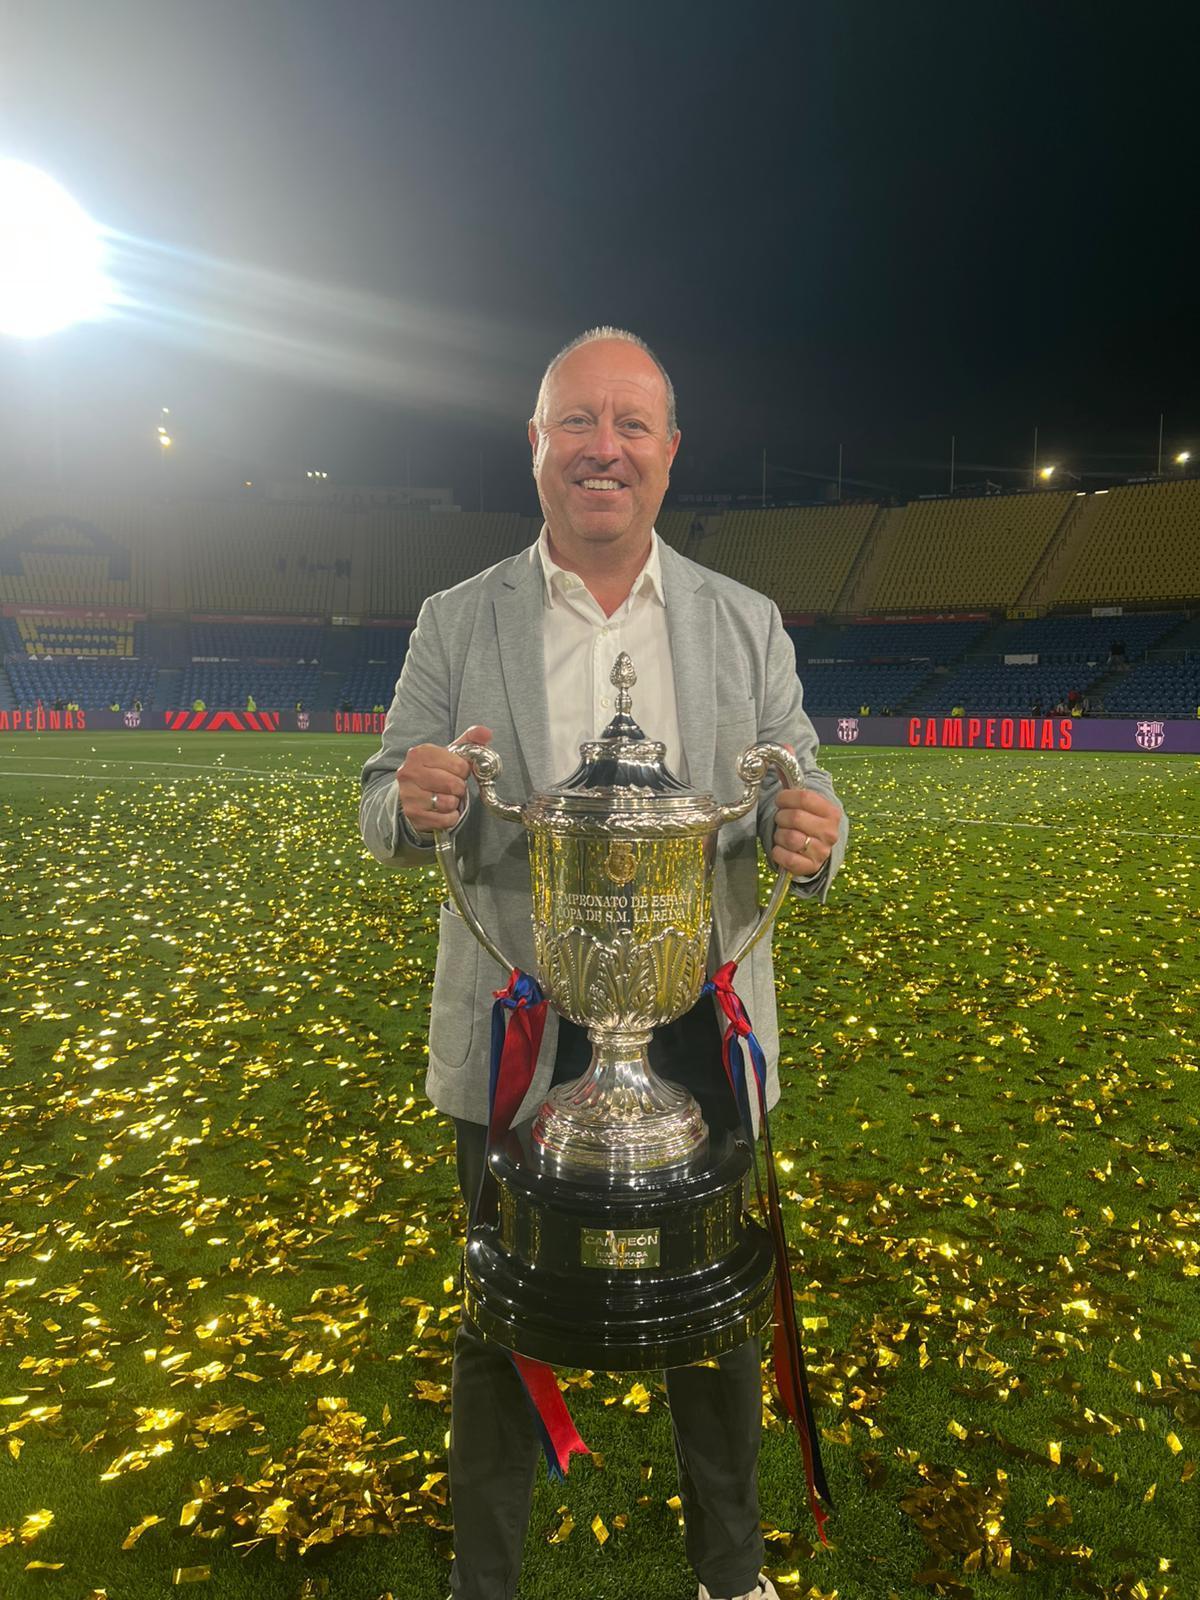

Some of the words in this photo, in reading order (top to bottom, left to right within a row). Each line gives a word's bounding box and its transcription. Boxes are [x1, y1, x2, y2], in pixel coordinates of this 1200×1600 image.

[908, 717, 1073, 750] CAMPEONAS
[552, 892, 628, 908] CAMPEONATO
[630, 895, 650, 908] DE
[557, 908, 583, 921] COPA
[585, 910, 602, 922] DE
[605, 911, 631, 923] S.M.
[633, 911, 650, 922] LA
